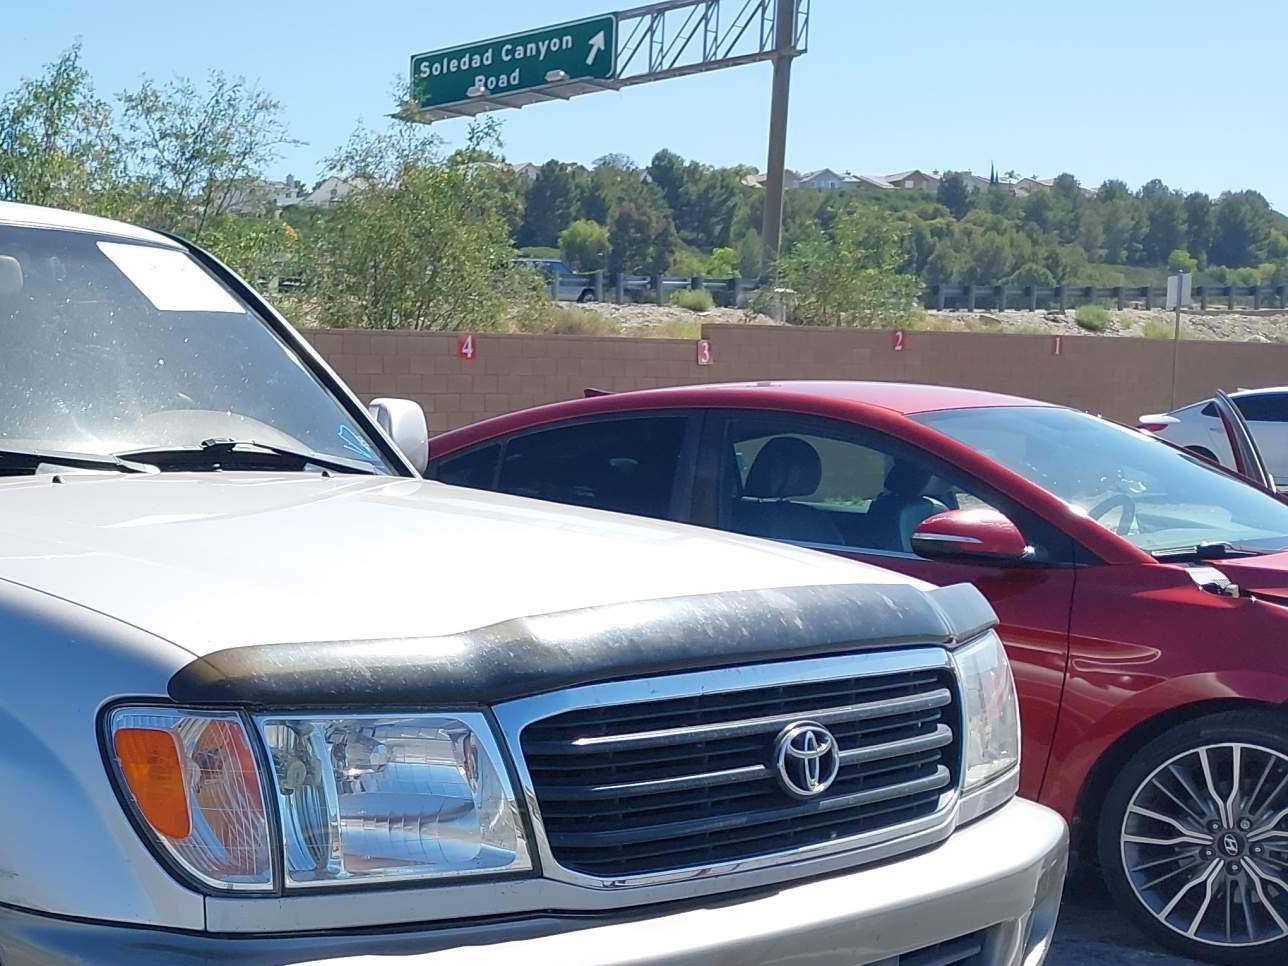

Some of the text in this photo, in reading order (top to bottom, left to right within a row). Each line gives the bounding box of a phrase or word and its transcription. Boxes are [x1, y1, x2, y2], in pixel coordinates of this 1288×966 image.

[420, 35, 573, 78] Soledad Canyon
[475, 68, 520, 90] Road
[462, 335, 473, 358] 4
[894, 331, 903, 351] 2
[701, 342, 710, 363] 3
